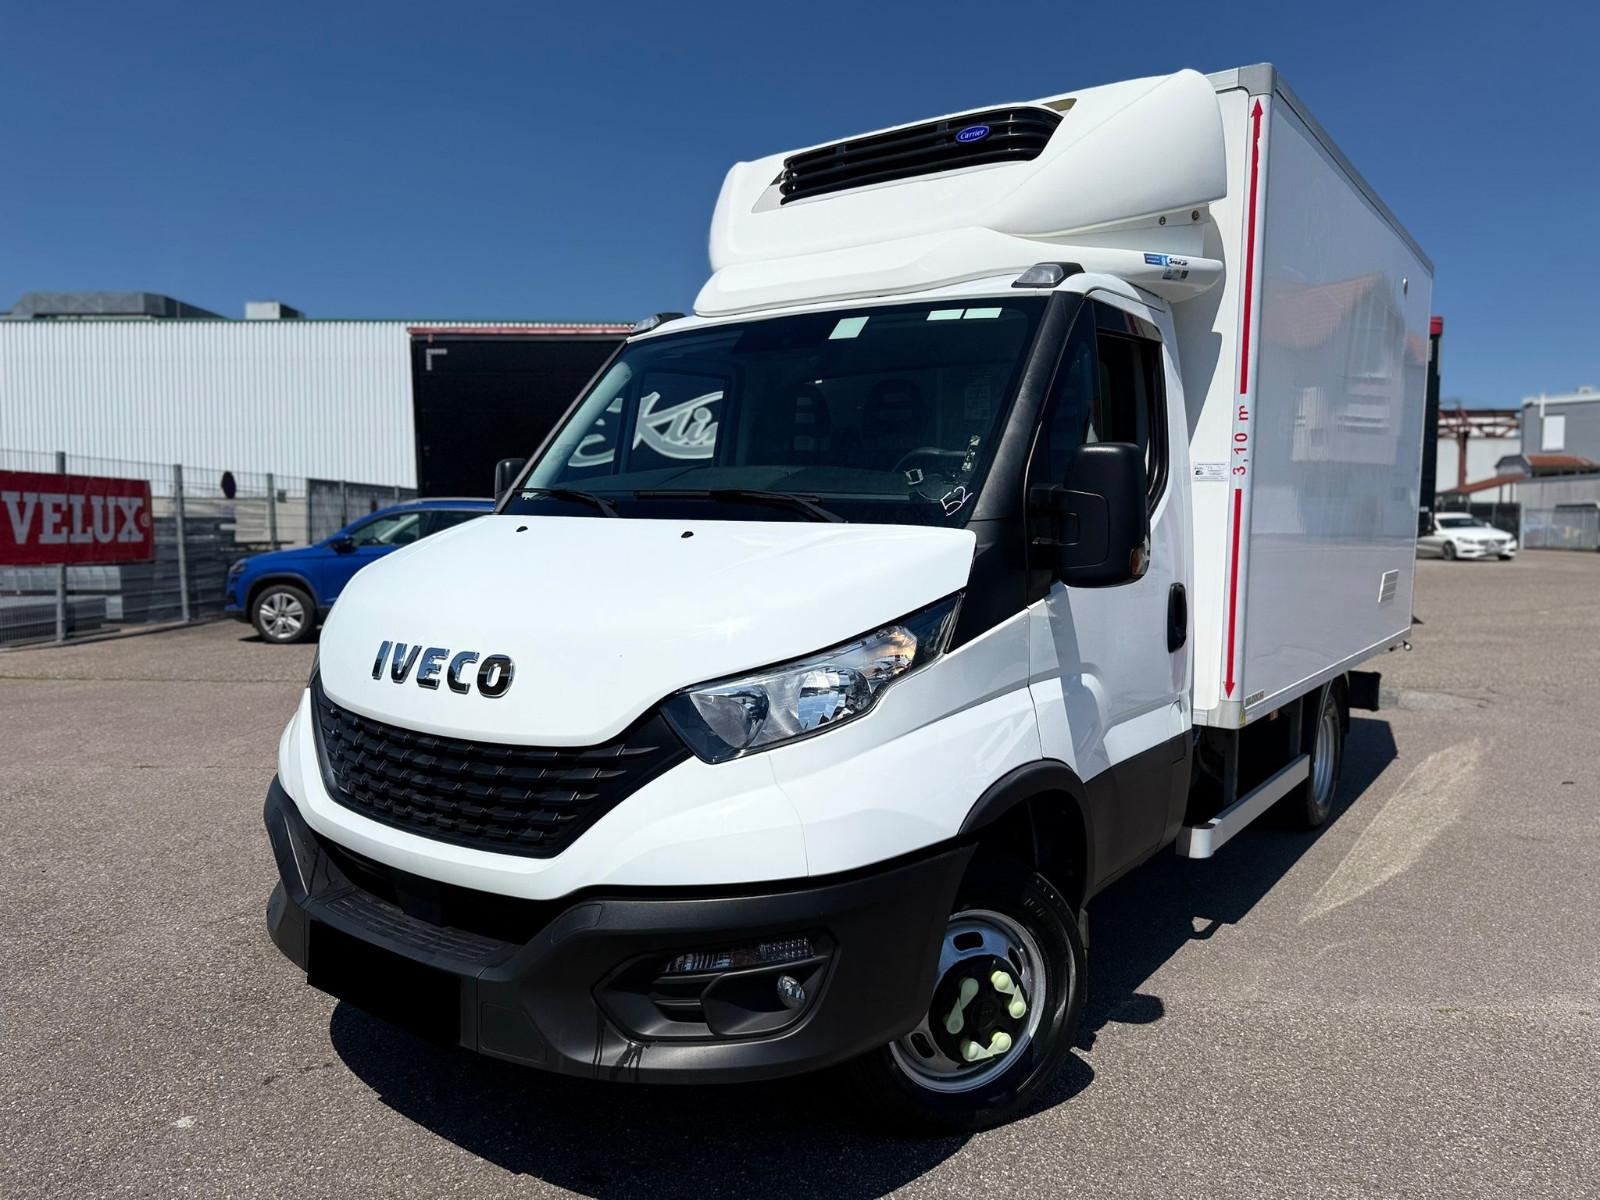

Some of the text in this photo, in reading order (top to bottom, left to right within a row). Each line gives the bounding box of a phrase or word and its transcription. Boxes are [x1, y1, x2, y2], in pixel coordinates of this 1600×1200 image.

[1232, 405, 1249, 476] 3,10 m
[1, 490, 144, 545] VELUX
[371, 640, 516, 699] IVECO
